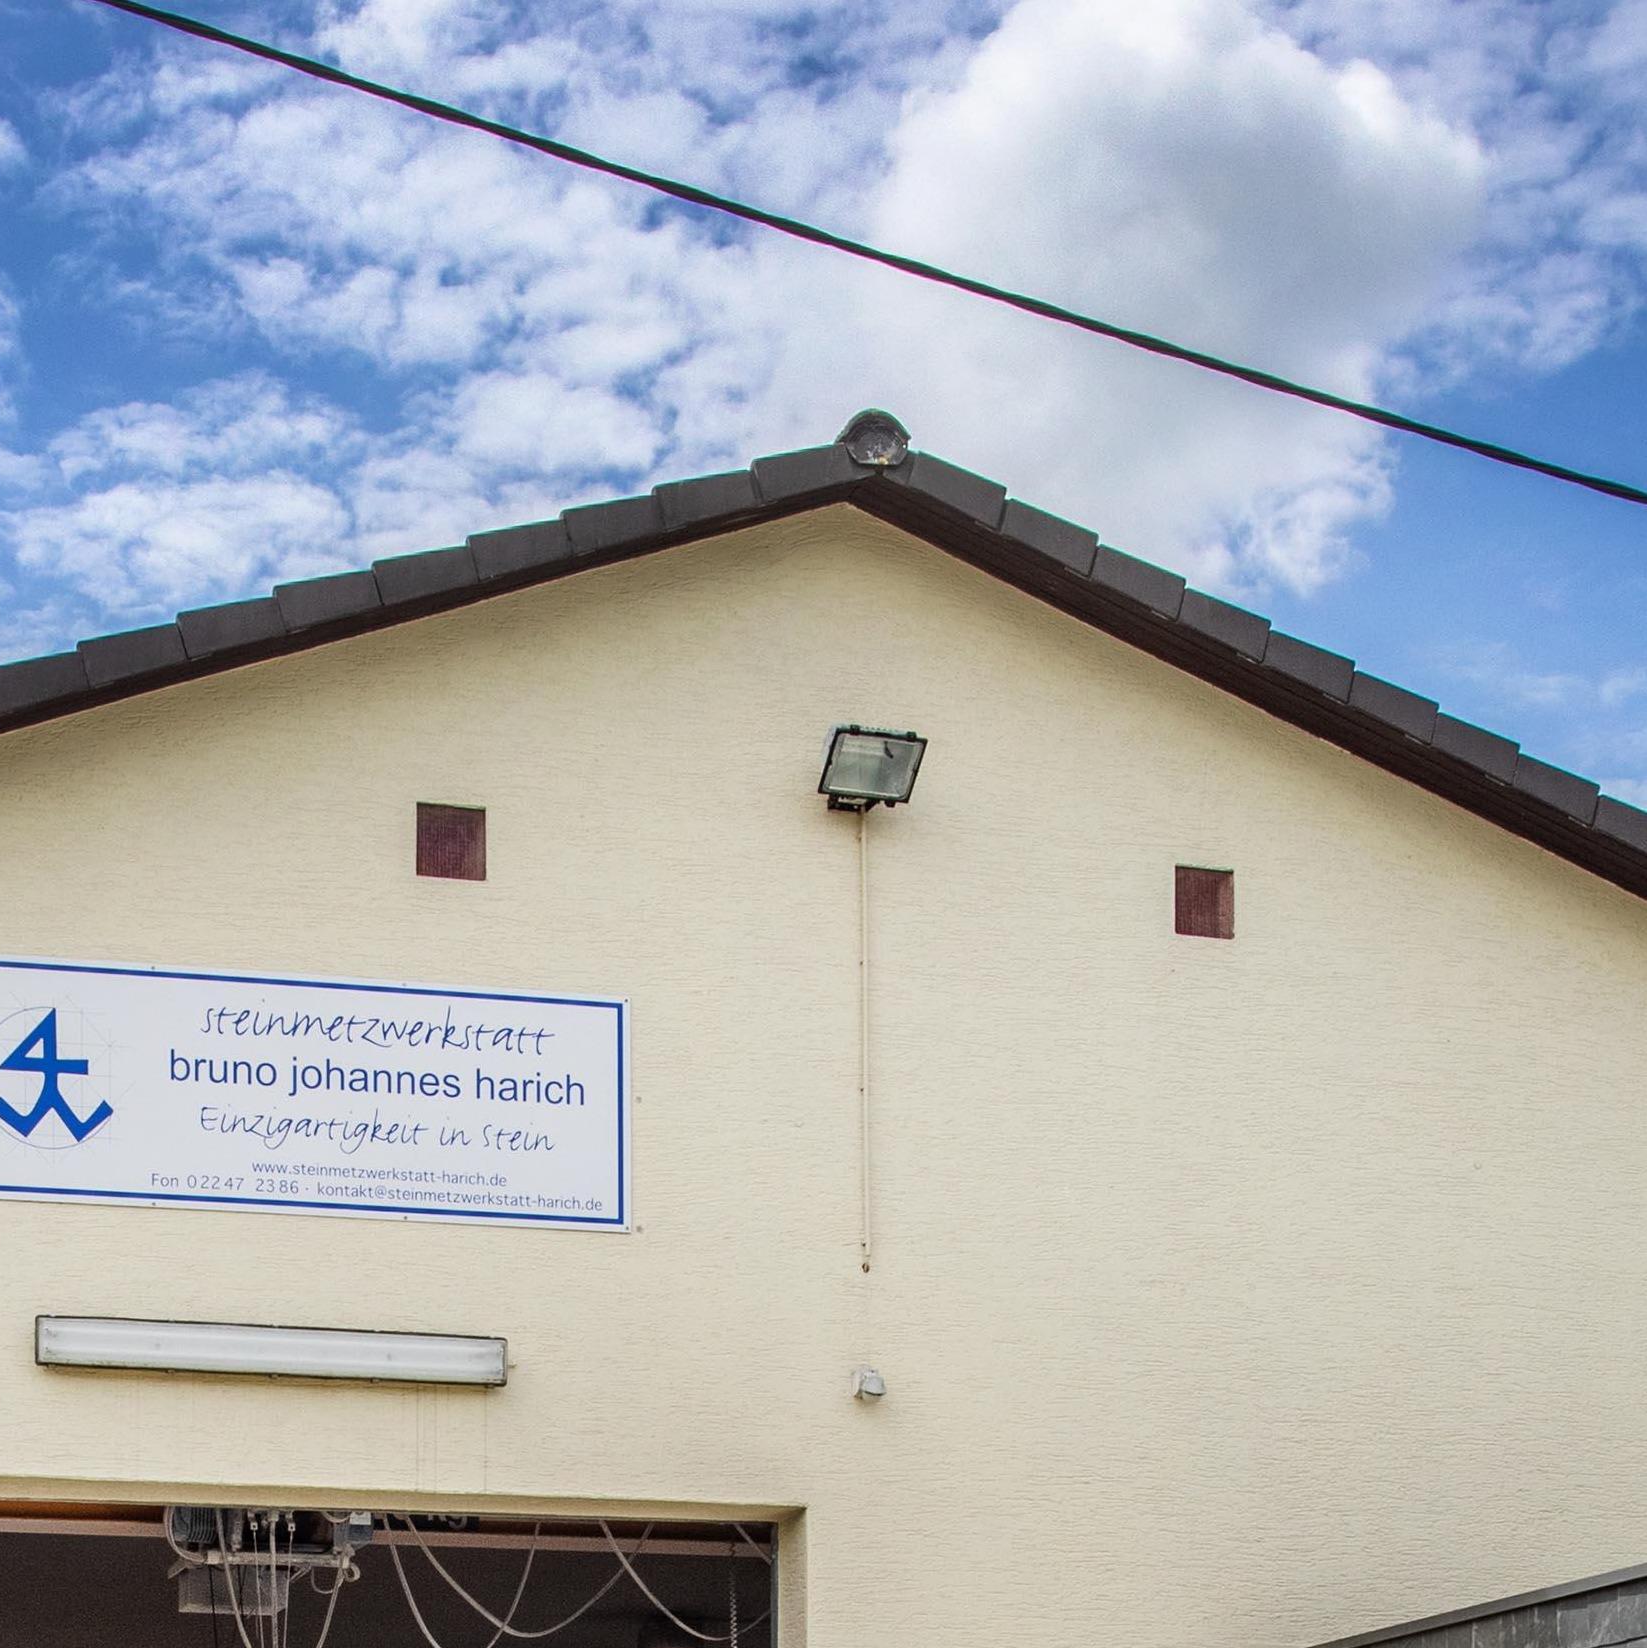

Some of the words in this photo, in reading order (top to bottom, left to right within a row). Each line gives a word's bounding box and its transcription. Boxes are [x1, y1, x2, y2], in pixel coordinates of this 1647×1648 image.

[200, 1000, 555, 1055] steinmetzwerkstatt
[170, 1048, 277, 1087] bruno
[288, 1055, 461, 1099] johannes
[476, 1067, 585, 1106] harich
[200, 1103, 429, 1155] Einzigartigkeit
[439, 1116, 472, 1147] in
[151, 1172, 180, 1188] Fon
[316, 1181, 603, 1212] kontakt@steinmetzwerkstatt-harich.de
[252, 1162, 508, 1188] www.steinmetzwerkstatt-harich.de
